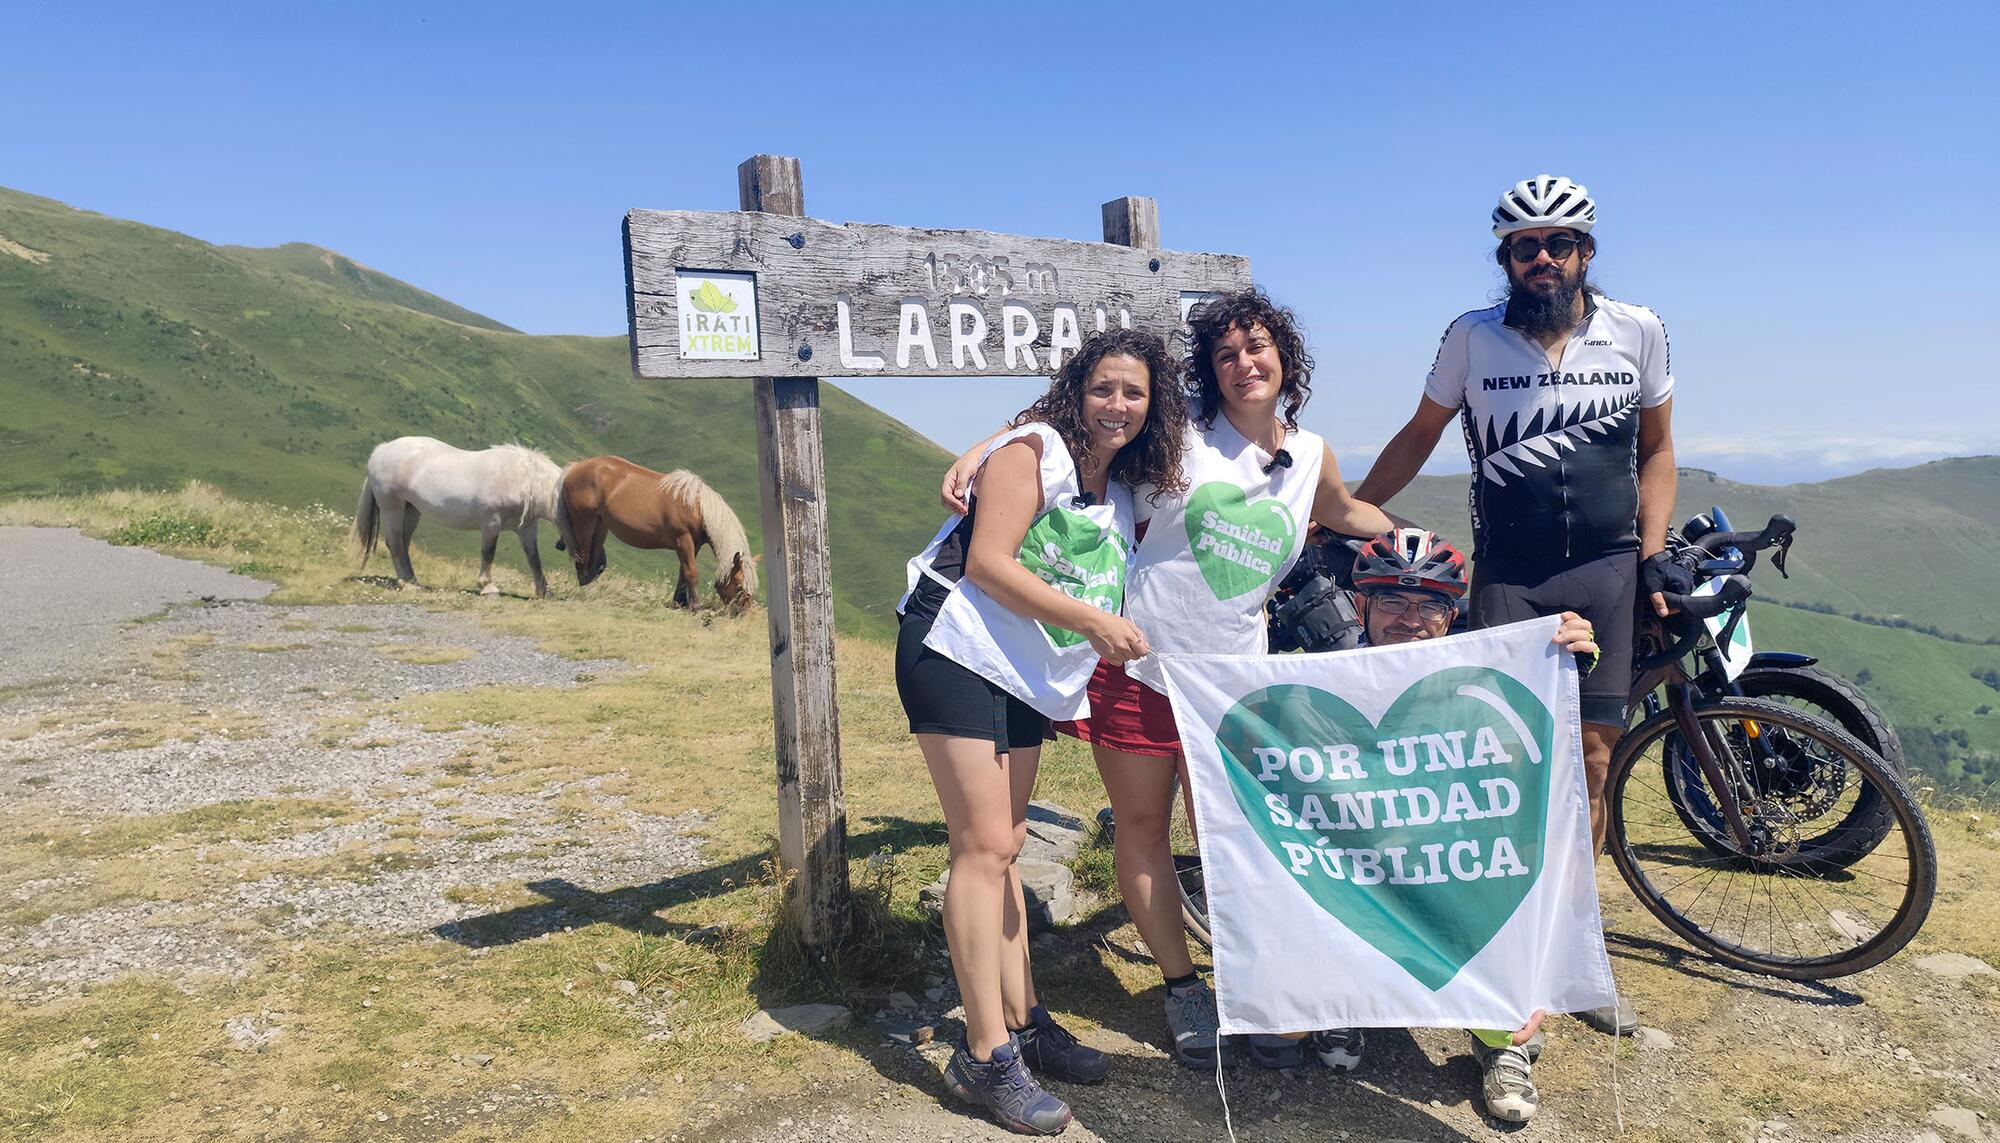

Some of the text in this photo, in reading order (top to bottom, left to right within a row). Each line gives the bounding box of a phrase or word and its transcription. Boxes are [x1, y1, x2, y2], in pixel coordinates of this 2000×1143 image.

[1025, 262, 1060, 296] m
[687, 334, 752, 353] XTREM
[1483, 371, 1635, 391] NEW ZEALAND
[1196, 532, 1272, 576] Pública
[1200, 511, 1284, 556] Sanidad
[1252, 727, 1512, 783] POR UNA
[1264, 777, 1521, 830] SANIDAD
[1281, 836, 1529, 886] PÚBLICA
